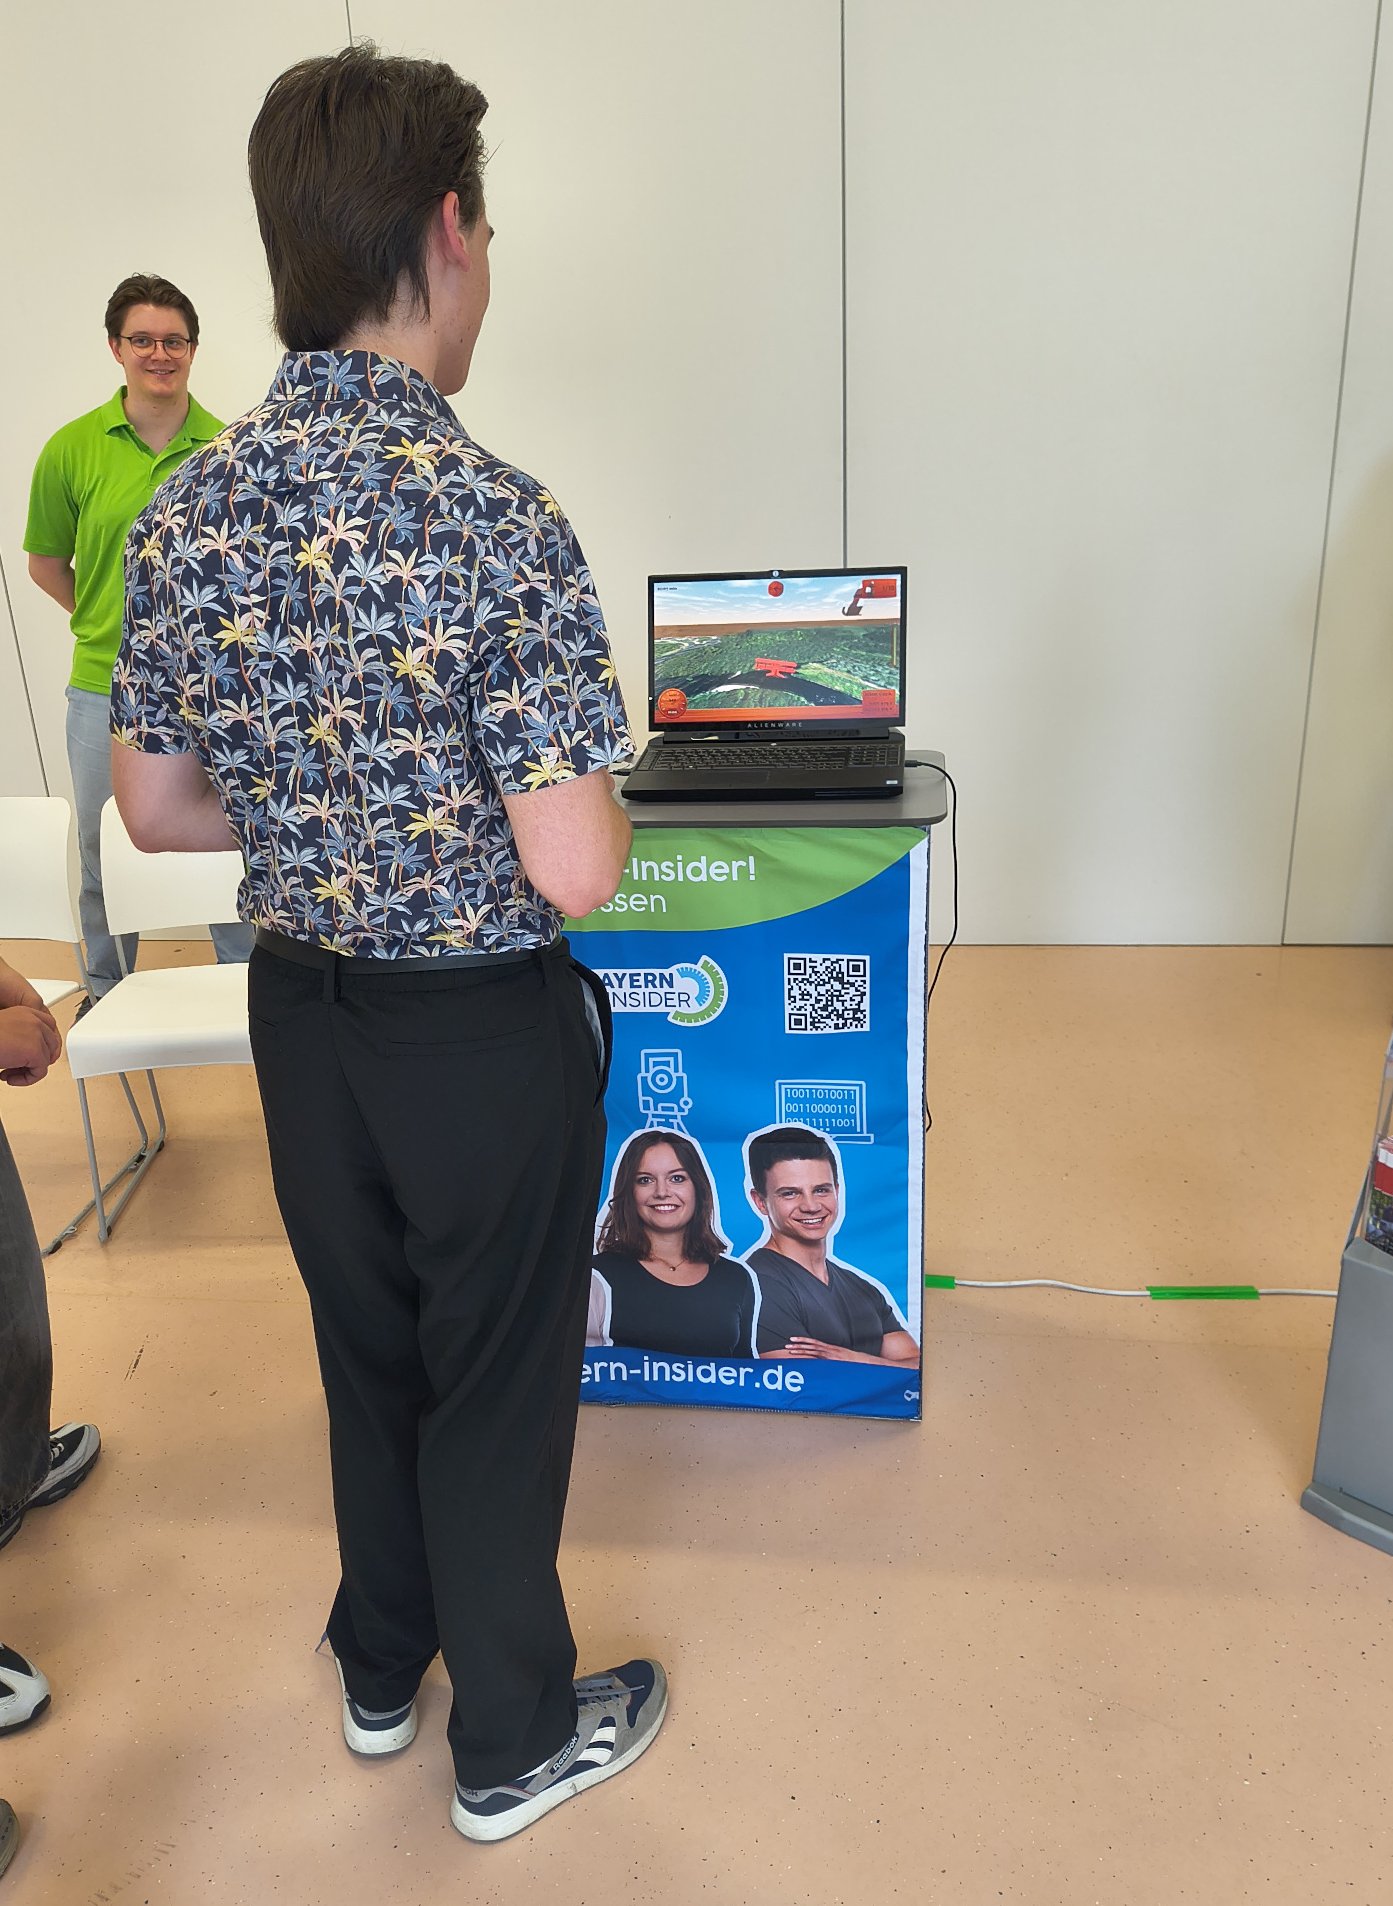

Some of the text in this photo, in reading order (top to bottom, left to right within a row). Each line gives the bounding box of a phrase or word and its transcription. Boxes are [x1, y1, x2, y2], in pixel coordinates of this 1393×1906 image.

[592, 893, 667, 913] ssen
[612, 991, 691, 1008] NSIDER
[786, 1088, 856, 1100] 10011010011
[785, 1103, 856, 1115] 00110000110
[552, 1735, 578, 1771] Reebok
